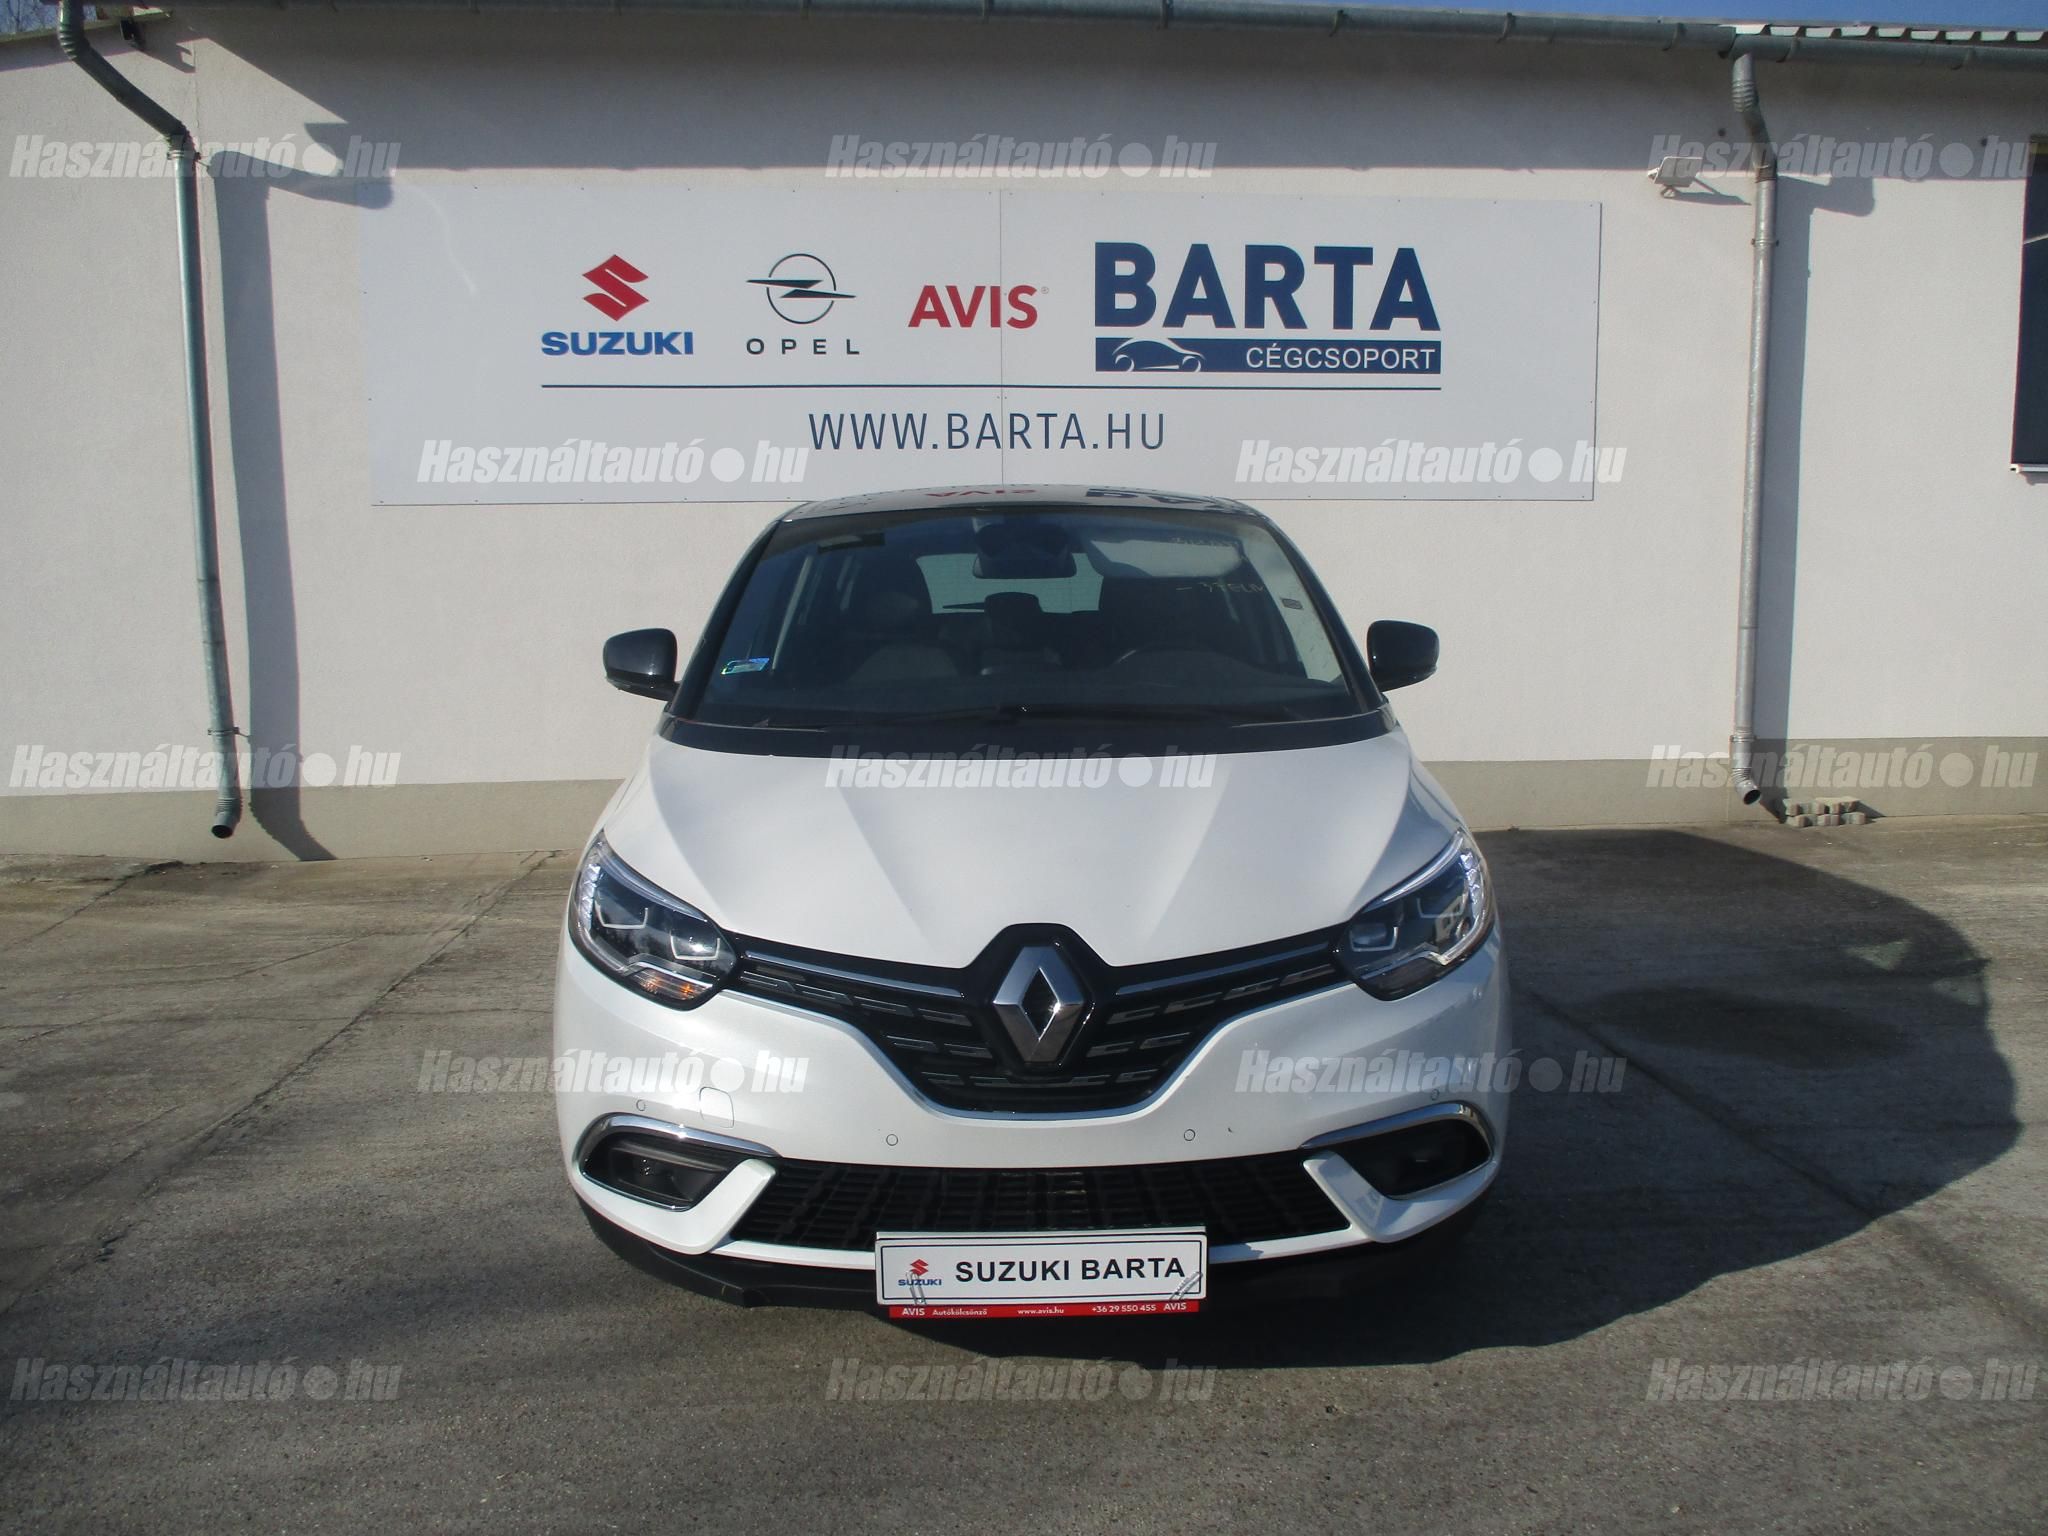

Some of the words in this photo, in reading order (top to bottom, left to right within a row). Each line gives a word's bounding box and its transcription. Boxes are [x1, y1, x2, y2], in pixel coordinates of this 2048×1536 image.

[1095, 241, 1441, 331] BARTA
[908, 285, 1039, 329] AVIS
[541, 331, 694, 356] SUZUKI
[746, 338, 860, 355] OPEL
[1245, 343, 1436, 370] CÉGCSOPORT
[808, 412, 1166, 451] WWW.BARTA.HU
[956, 1260, 1070, 1283] SUZUKI
[1081, 1257, 1186, 1280] BARTA
[902, 1308, 925, 1316] AVIS
[1017, 1306, 1064, 1315] www.avis.hu
[1140, 1304, 1156, 1312] 455
[1163, 1302, 1187, 1311] AVIS
